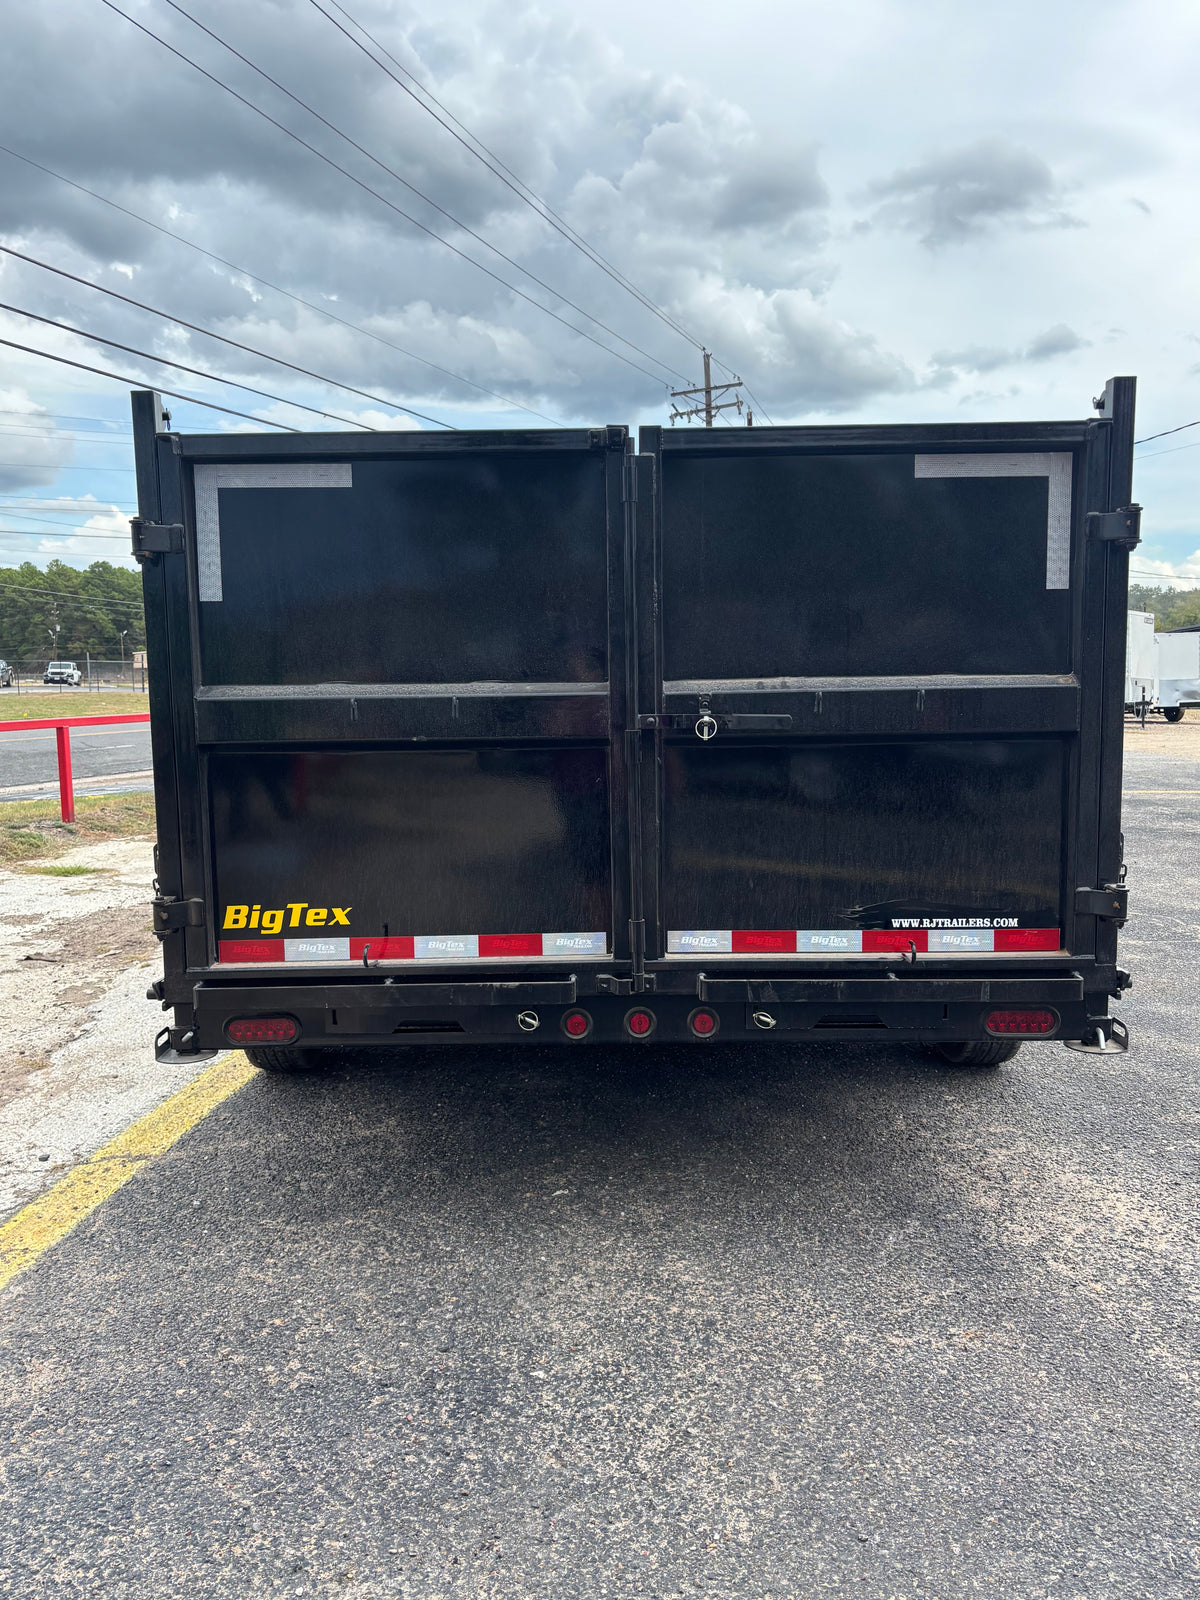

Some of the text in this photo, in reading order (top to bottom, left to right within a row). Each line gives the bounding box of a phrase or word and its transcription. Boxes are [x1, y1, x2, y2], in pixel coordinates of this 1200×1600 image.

[222, 903, 353, 935] BigTex
[891, 918, 1018, 928] WWW.RJTRAILERS.COM
[492, 939, 529, 949] BigTex
[556, 938, 593, 947] BigTex
[681, 936, 718, 946] BigTex
[745, 936, 783, 946] BigTex
[810, 936, 848, 946] BigTex
[942, 935, 981, 945] BigTex
[298, 943, 337, 953] BigTex
[428, 941, 465, 950] BigTex
